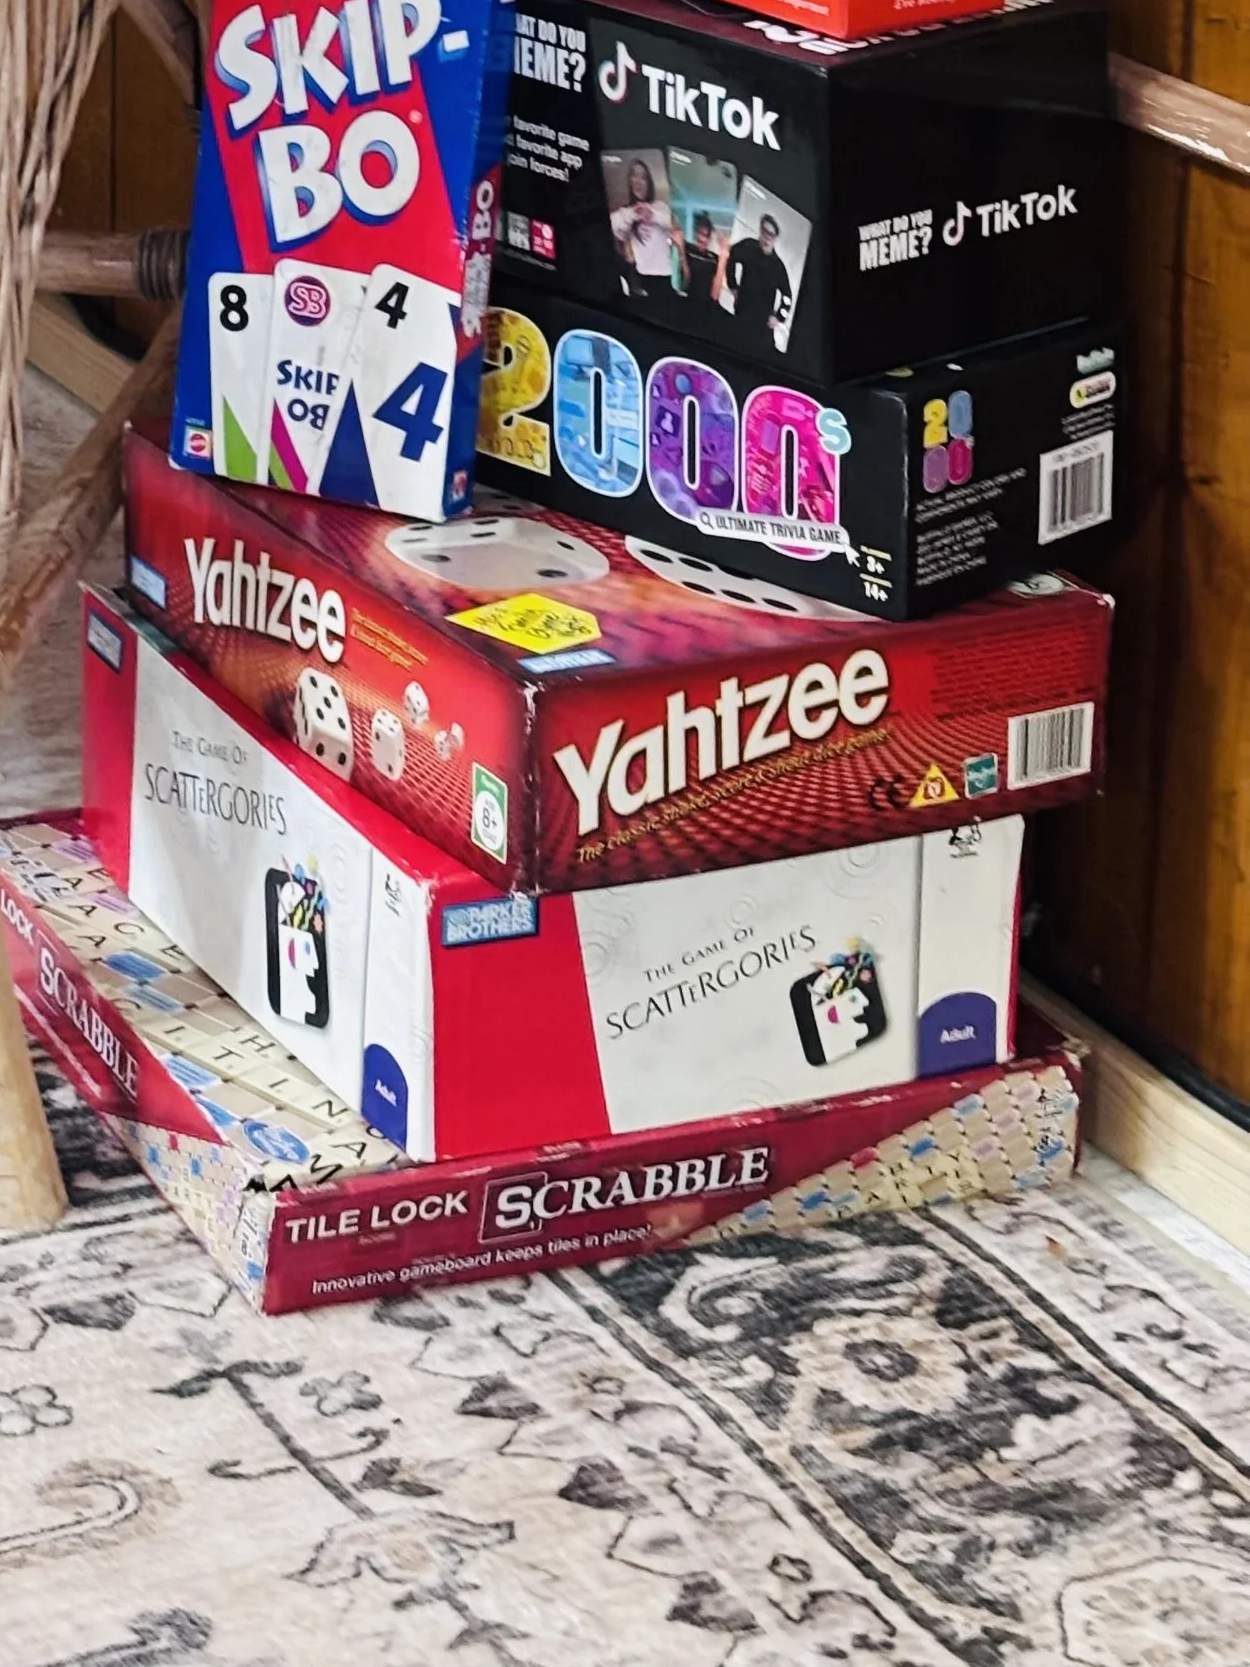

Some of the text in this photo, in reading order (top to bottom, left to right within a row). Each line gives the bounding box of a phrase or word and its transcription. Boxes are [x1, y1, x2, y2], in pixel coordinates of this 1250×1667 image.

[537, 18, 557, 44] DO
[558, 24, 586, 53] YOU
[513, 36, 587, 93] EME?
[513, 114, 591, 152] favorite game
[642, 64, 781, 152] TikTok
[257, 110, 421, 244] BO
[516, 134, 583, 170] favorite app
[892, 214, 909, 234] DO
[909, 208, 933, 229] YOU
[975, 184, 1078, 238] TikTok
[859, 225, 933, 272] MEME?
[219, 284, 249, 332] 8
[374, 281, 410, 330] 4
[372, 361, 449, 462] 4
[715, 515, 841, 544] ULTIMATE TRIVIA GAME
[184, 537, 347, 665] Yahtzee
[171, 730, 193, 753] THE
[553, 649, 891, 836] Yahtzee
[144, 762, 287, 836] SCATTERGORIES
[482, 807, 498, 829] 8+
[577, 845, 604, 863] The
[0, 888, 35, 947] LOCK
[605, 923, 819, 1041] SCATTERGORIES
[642, 963, 677, 985] THE
[681, 940, 730, 968] GAME
[40, 947, 140, 1098] SCRABBLE
[939, 1024, 976, 1045] Adult
[285, 1209, 360, 1245] TILE
[369, 1189, 469, 1231] LOCK
[494, 1146, 771, 1231] SCRABBLE
[312, 1221, 653, 1295] Innovative gameboard keeps tiles in place!
